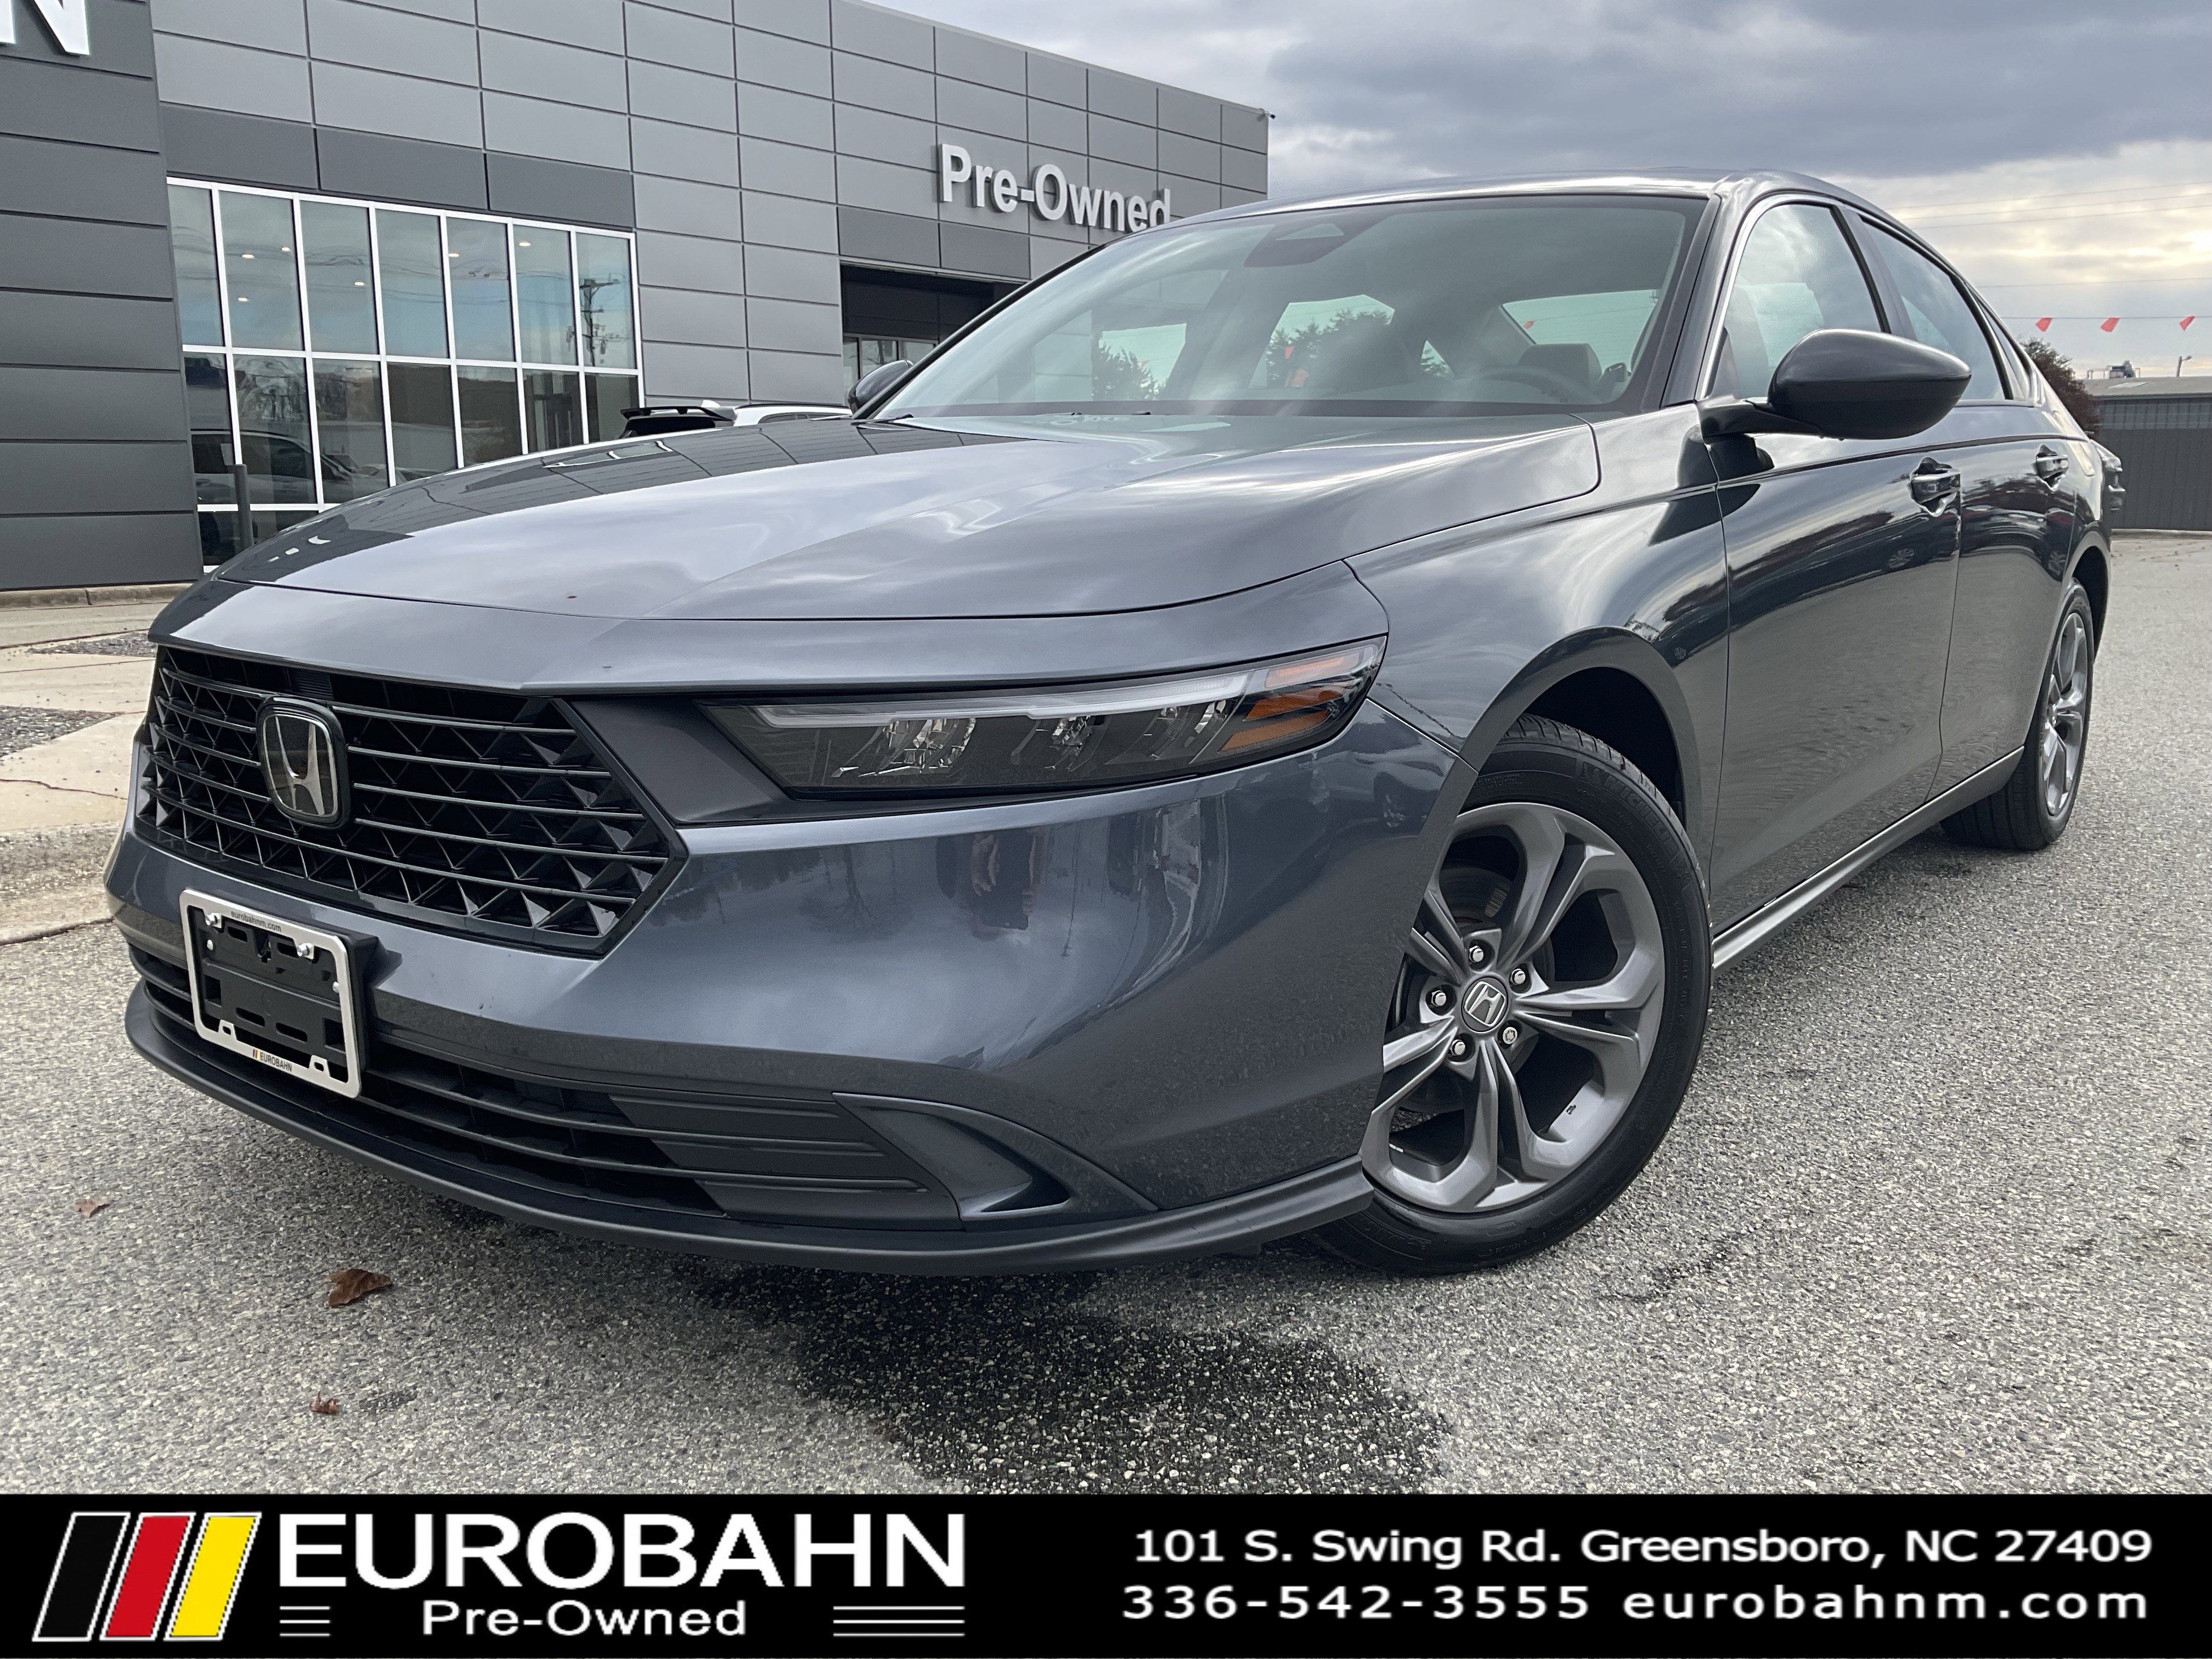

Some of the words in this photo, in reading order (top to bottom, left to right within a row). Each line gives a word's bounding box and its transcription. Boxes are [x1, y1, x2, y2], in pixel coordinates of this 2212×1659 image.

[940, 143, 1171, 233] Pre-Owned
[231, 911, 281, 933] eurobahnm.com
[260, 1052, 292, 1072] EUROBAHN
